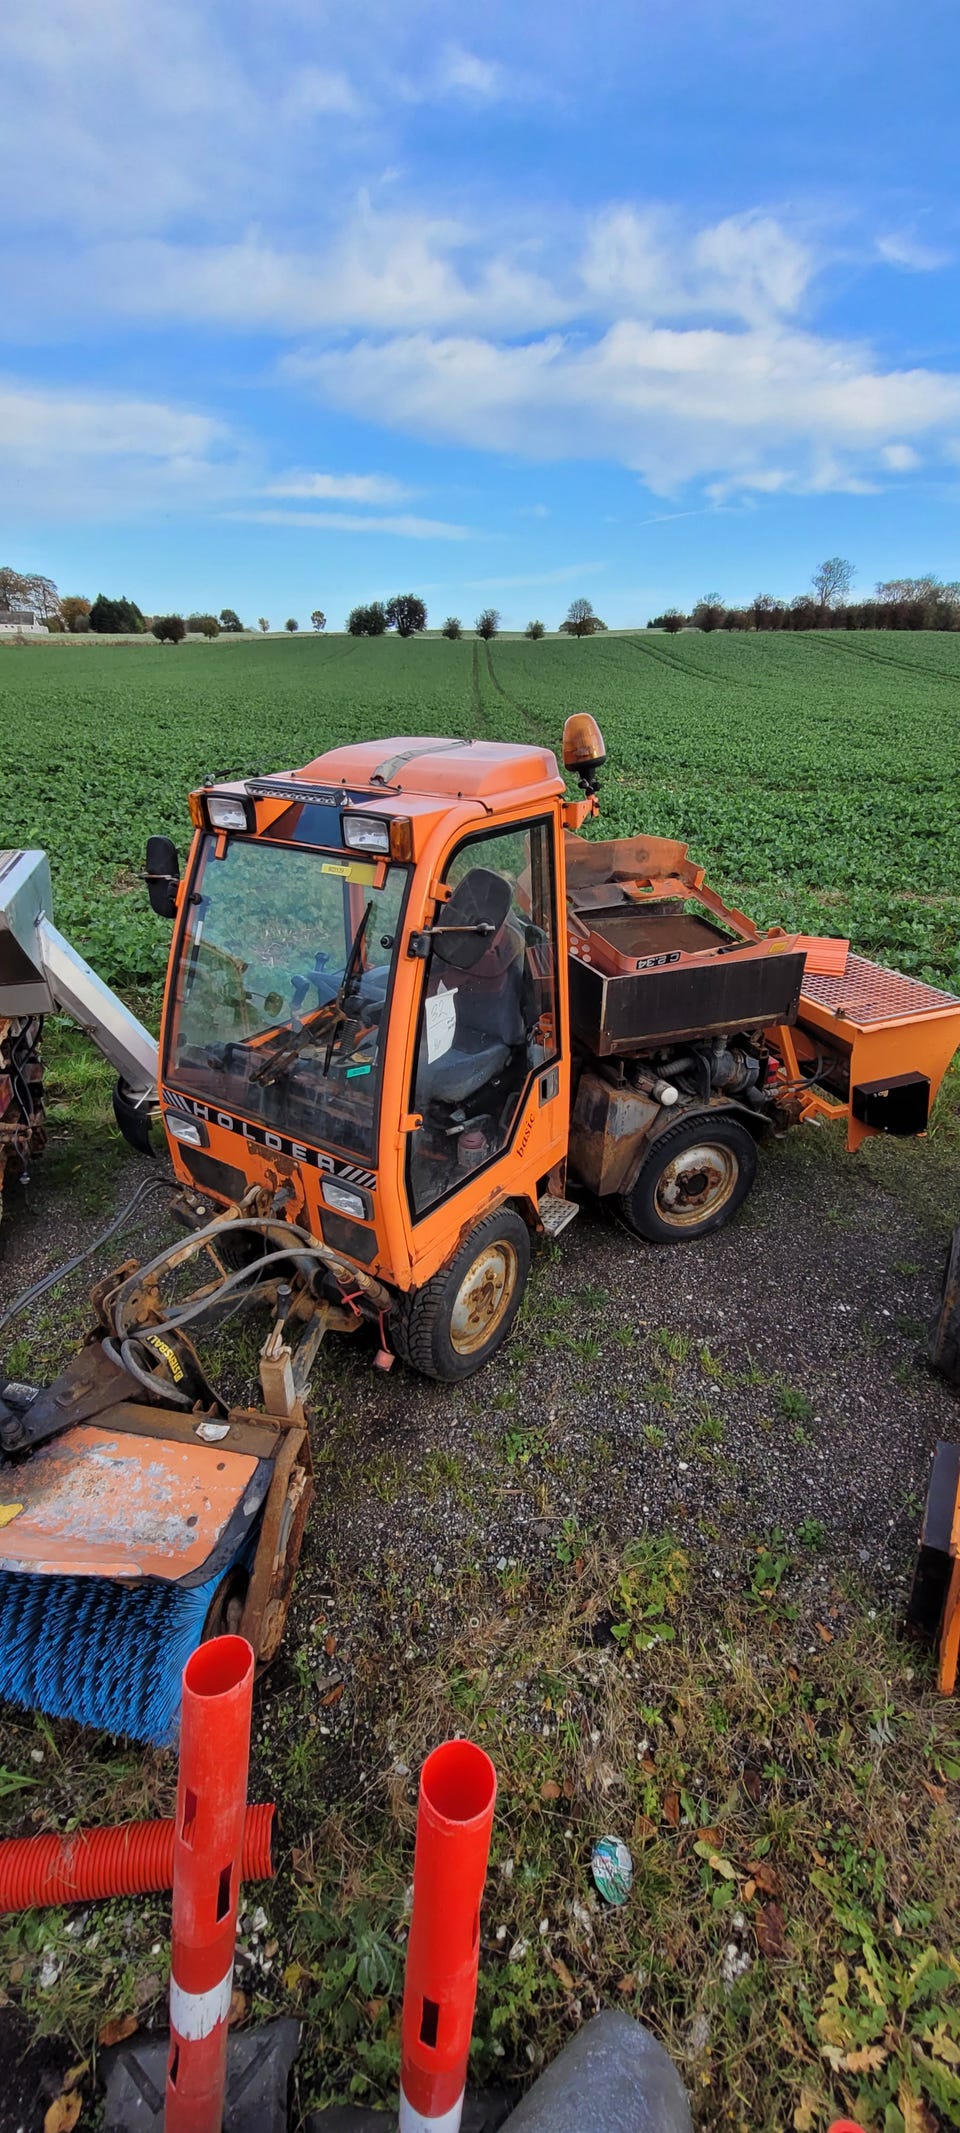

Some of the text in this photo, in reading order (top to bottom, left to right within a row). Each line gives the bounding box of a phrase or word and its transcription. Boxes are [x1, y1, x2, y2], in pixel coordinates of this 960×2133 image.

[638, 952, 680, 969] C 2.34
[193, 1102, 335, 1174] HOLDER
[516, 1112, 535, 1158] basic
